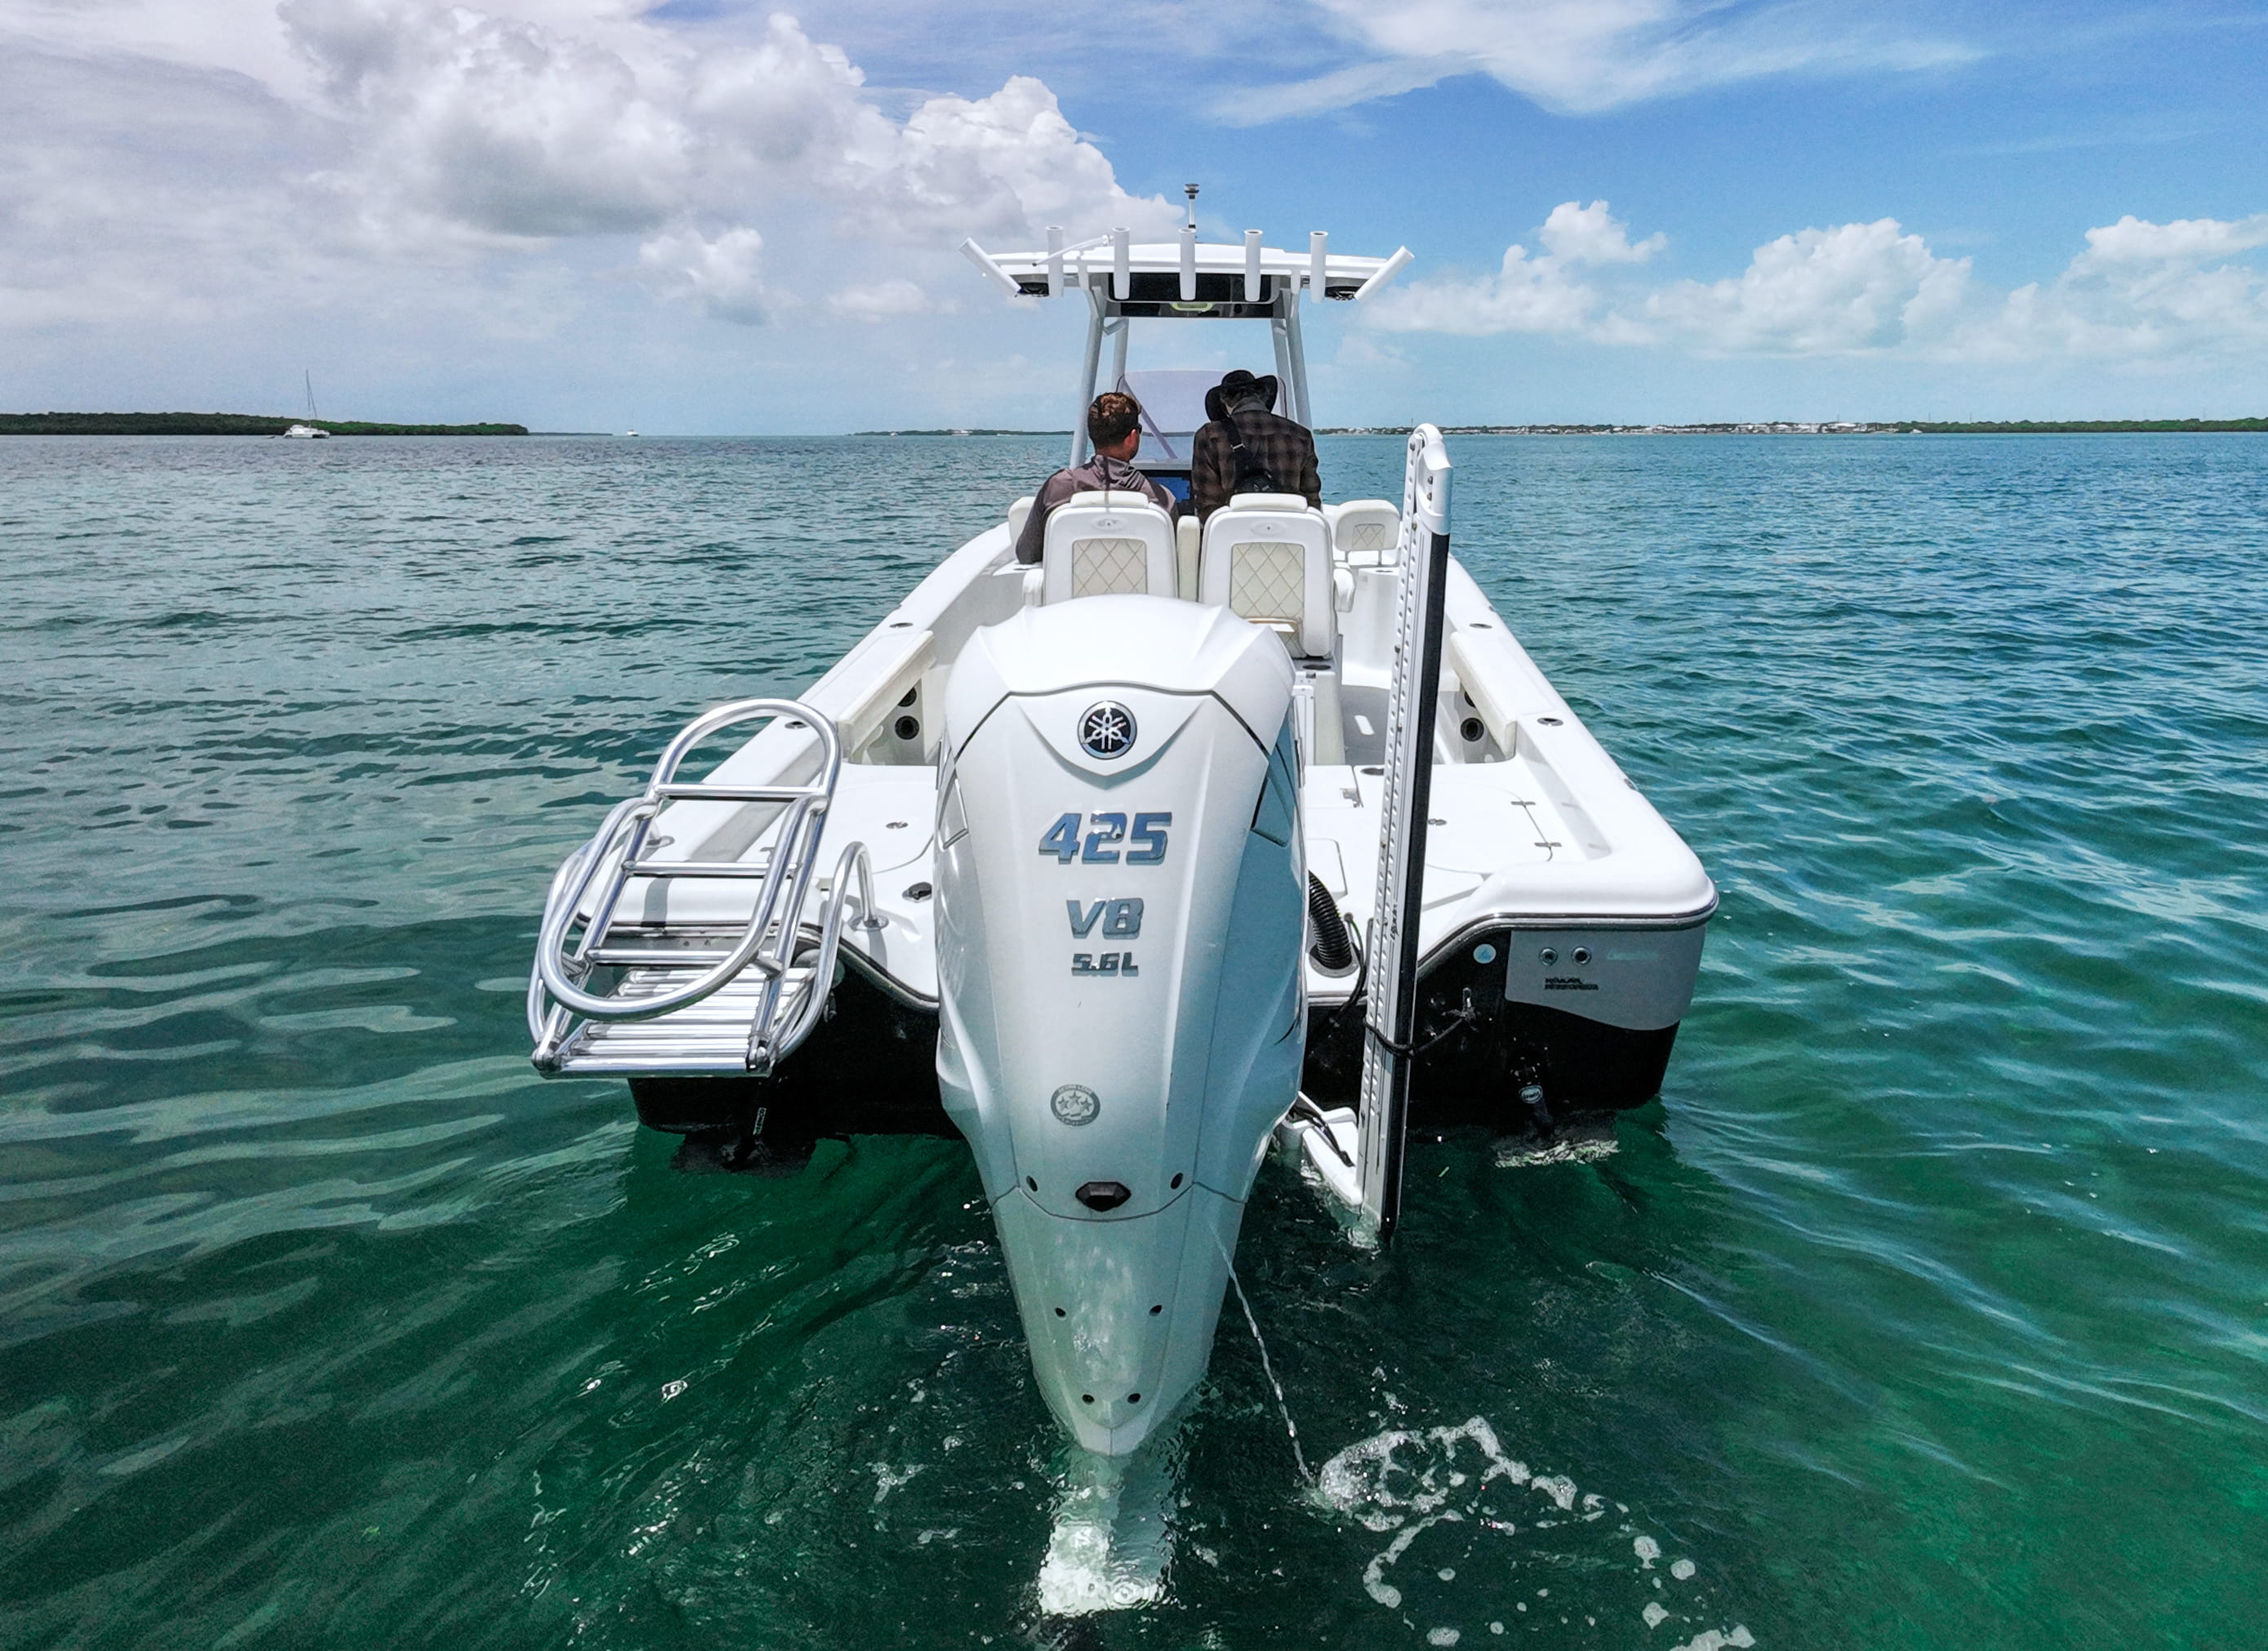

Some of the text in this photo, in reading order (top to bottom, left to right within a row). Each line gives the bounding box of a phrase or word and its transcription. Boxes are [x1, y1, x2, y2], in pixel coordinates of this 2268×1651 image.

[1038, 811, 1172, 866] 425
[1066, 897, 1145, 940] V8
[1071, 952, 1139, 977] 5.6L
